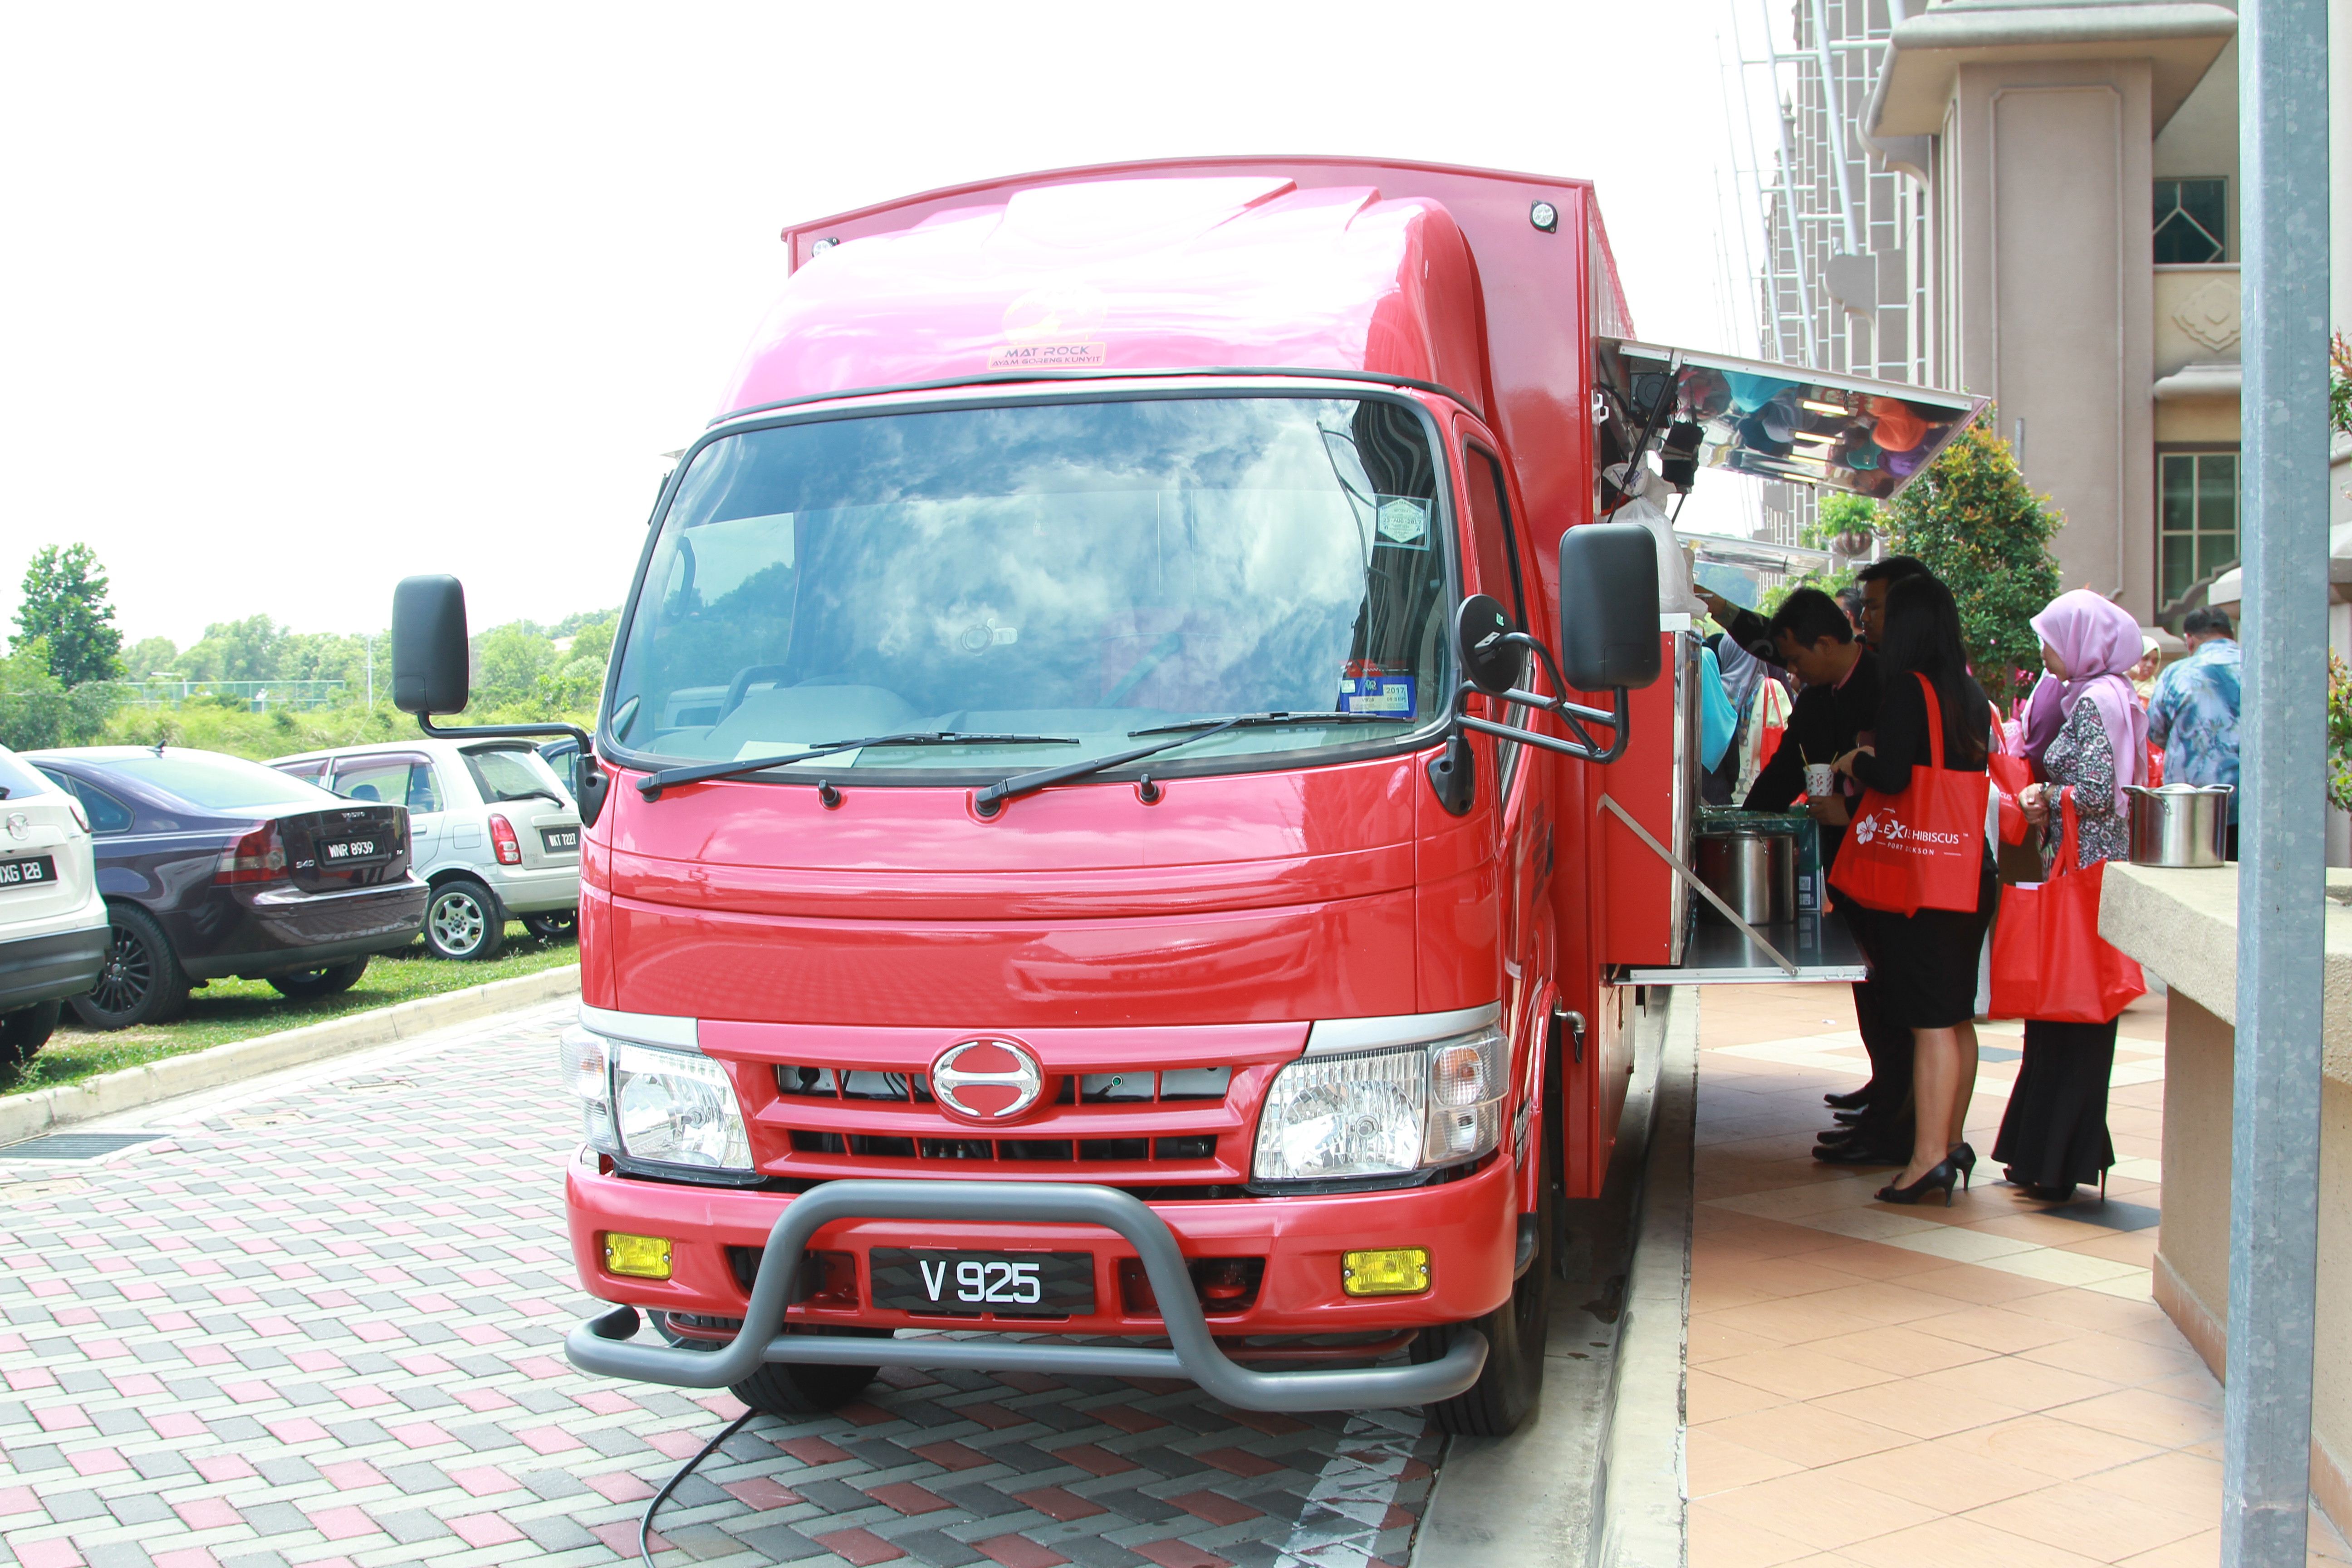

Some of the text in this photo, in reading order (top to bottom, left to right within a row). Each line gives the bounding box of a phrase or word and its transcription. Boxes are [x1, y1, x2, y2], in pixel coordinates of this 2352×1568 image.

[1005, 346, 1090, 358] MAT ROCK
[562, 833, 576, 846] 7227
[1912, 829, 1959, 844] HIBISCUS
[328, 841, 374, 858] WNR 8939
[1887, 842, 1935, 856] PORT DCKSON
[21, 862, 42, 880] 128
[920, 1259, 1041, 1304] V 925
